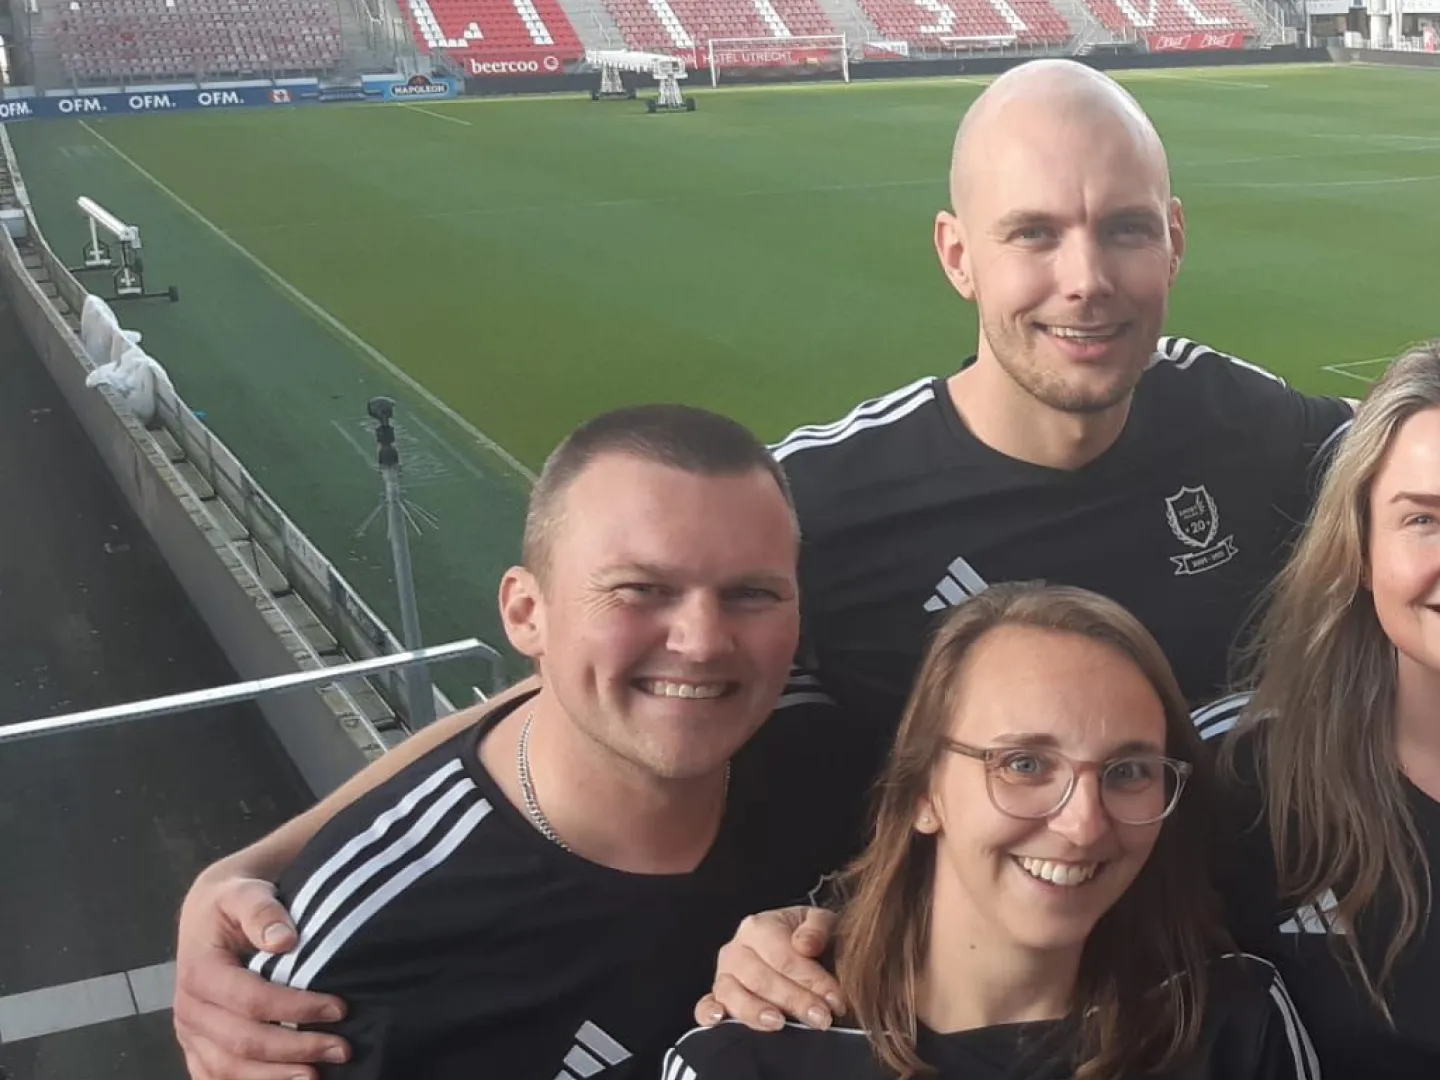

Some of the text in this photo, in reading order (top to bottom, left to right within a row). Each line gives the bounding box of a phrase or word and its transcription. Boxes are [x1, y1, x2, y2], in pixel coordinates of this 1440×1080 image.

[470, 58, 538, 74] beercoo
[395, 85, 445, 94] NAPOLEON
[58, 98, 107, 114] OFM.
[129, 94, 176, 110] OFM.
[198, 90, 244, 106] OFM.
[1190, 519, 1206, 534] 20
